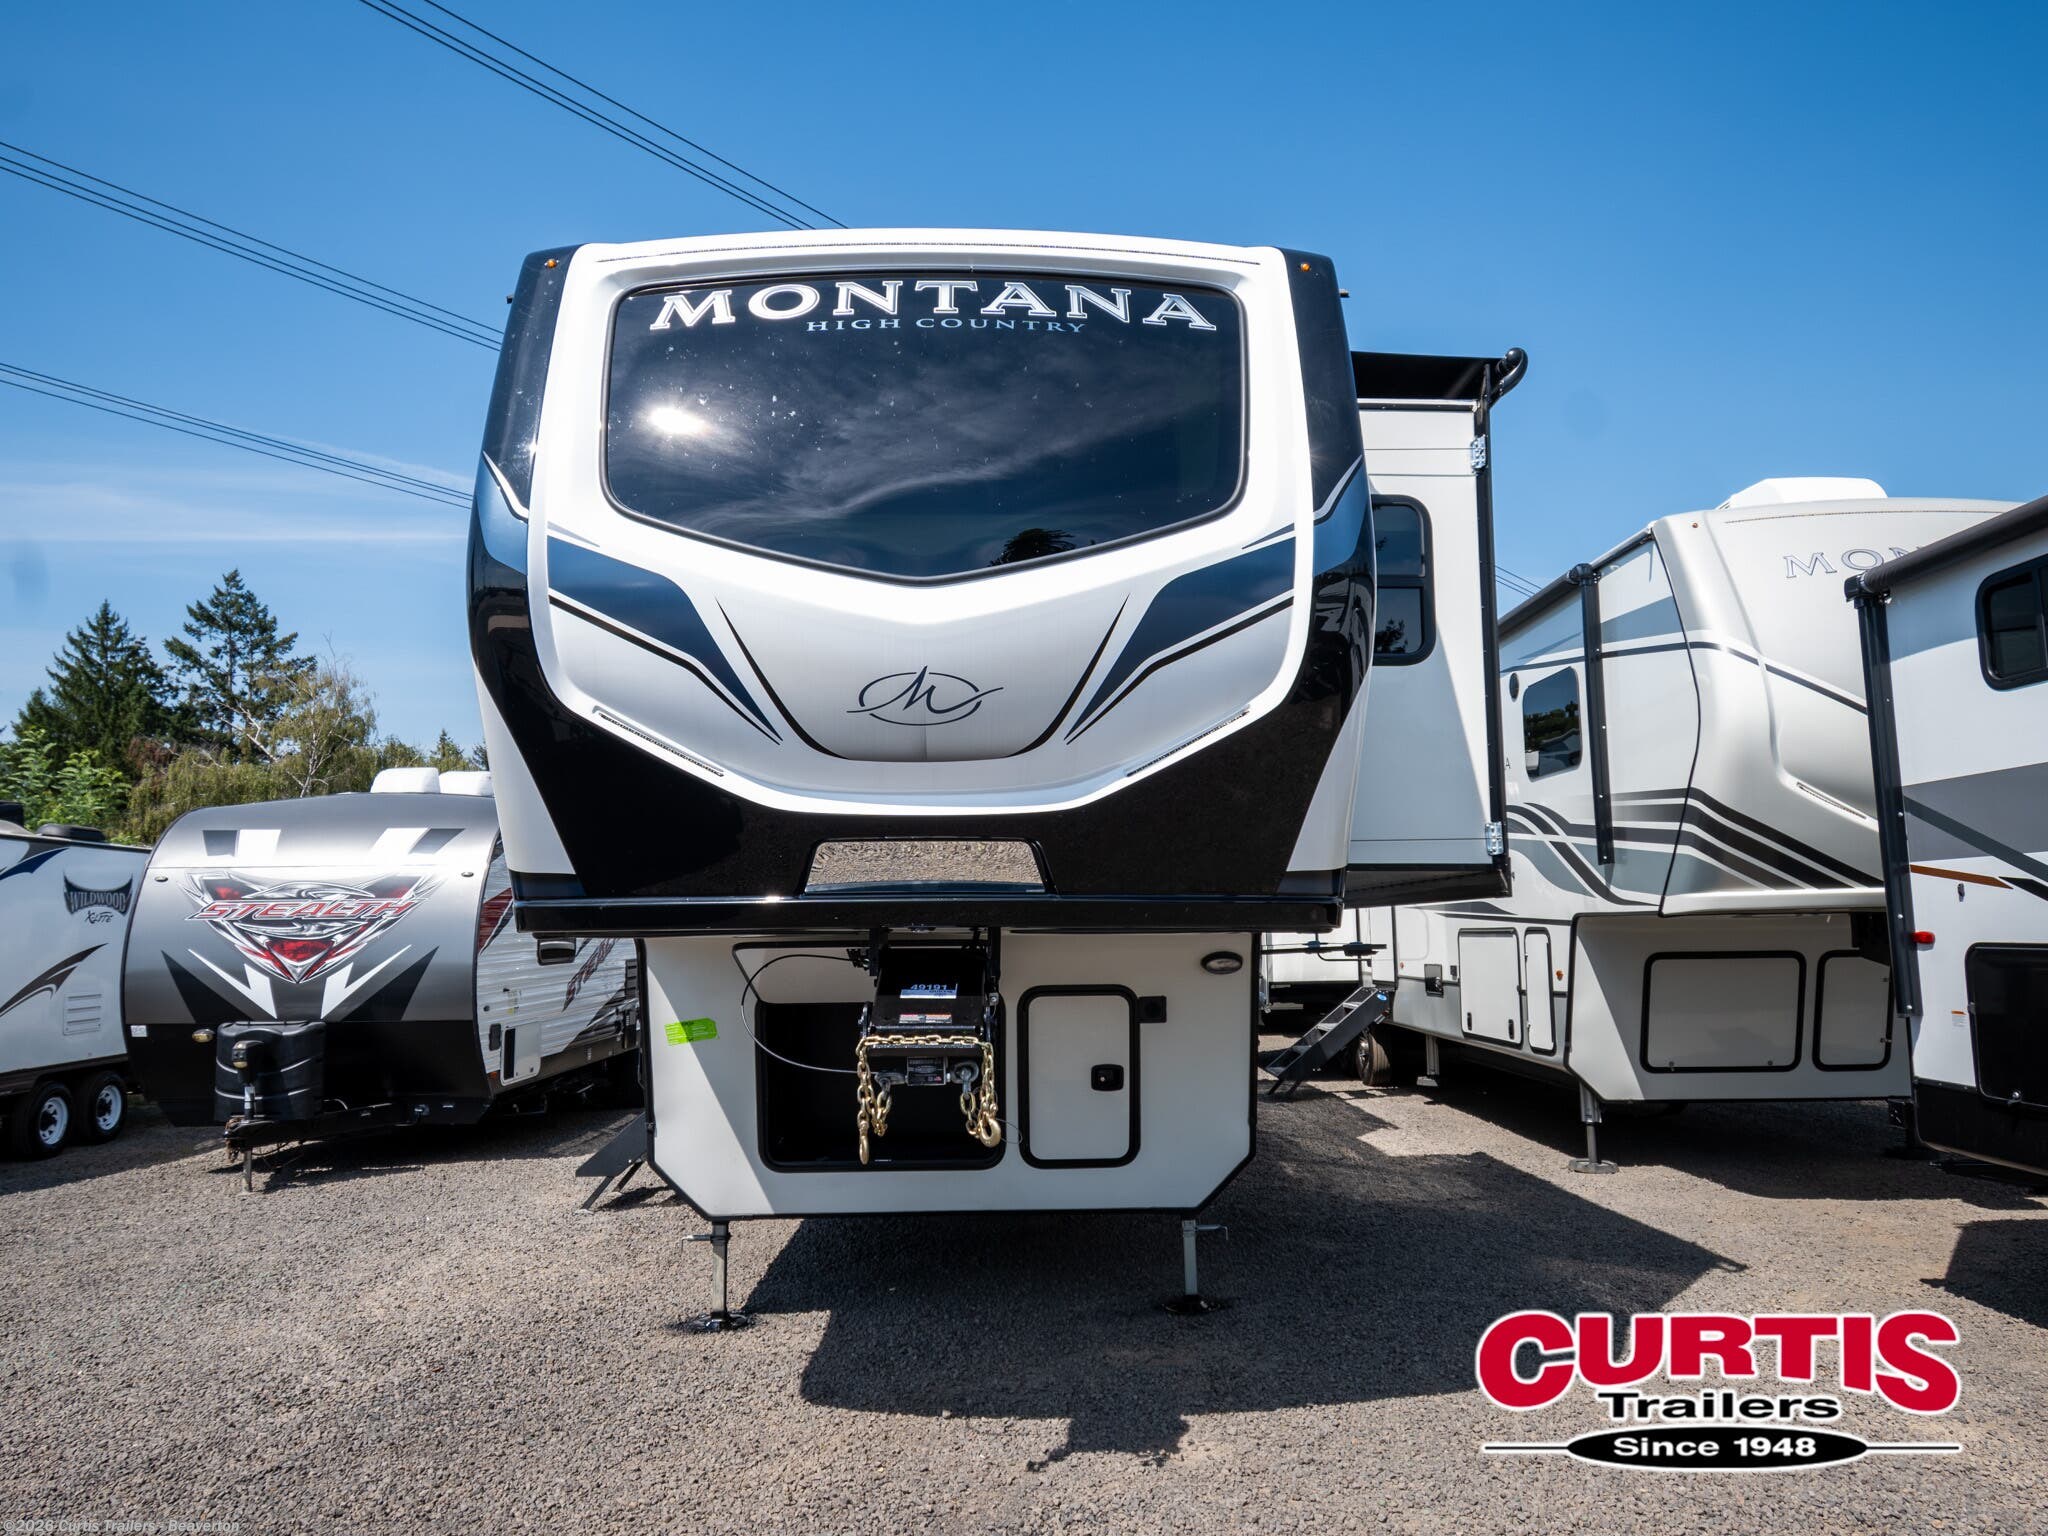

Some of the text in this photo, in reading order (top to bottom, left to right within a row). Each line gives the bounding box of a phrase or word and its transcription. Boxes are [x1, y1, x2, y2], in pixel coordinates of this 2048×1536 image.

[649, 280, 1217, 331] MONTANA
[806, 317, 1086, 333] HIGH COUNTRY
[67, 890, 127, 914] WILDWOOD
[195, 899, 419, 921] STEALTH
